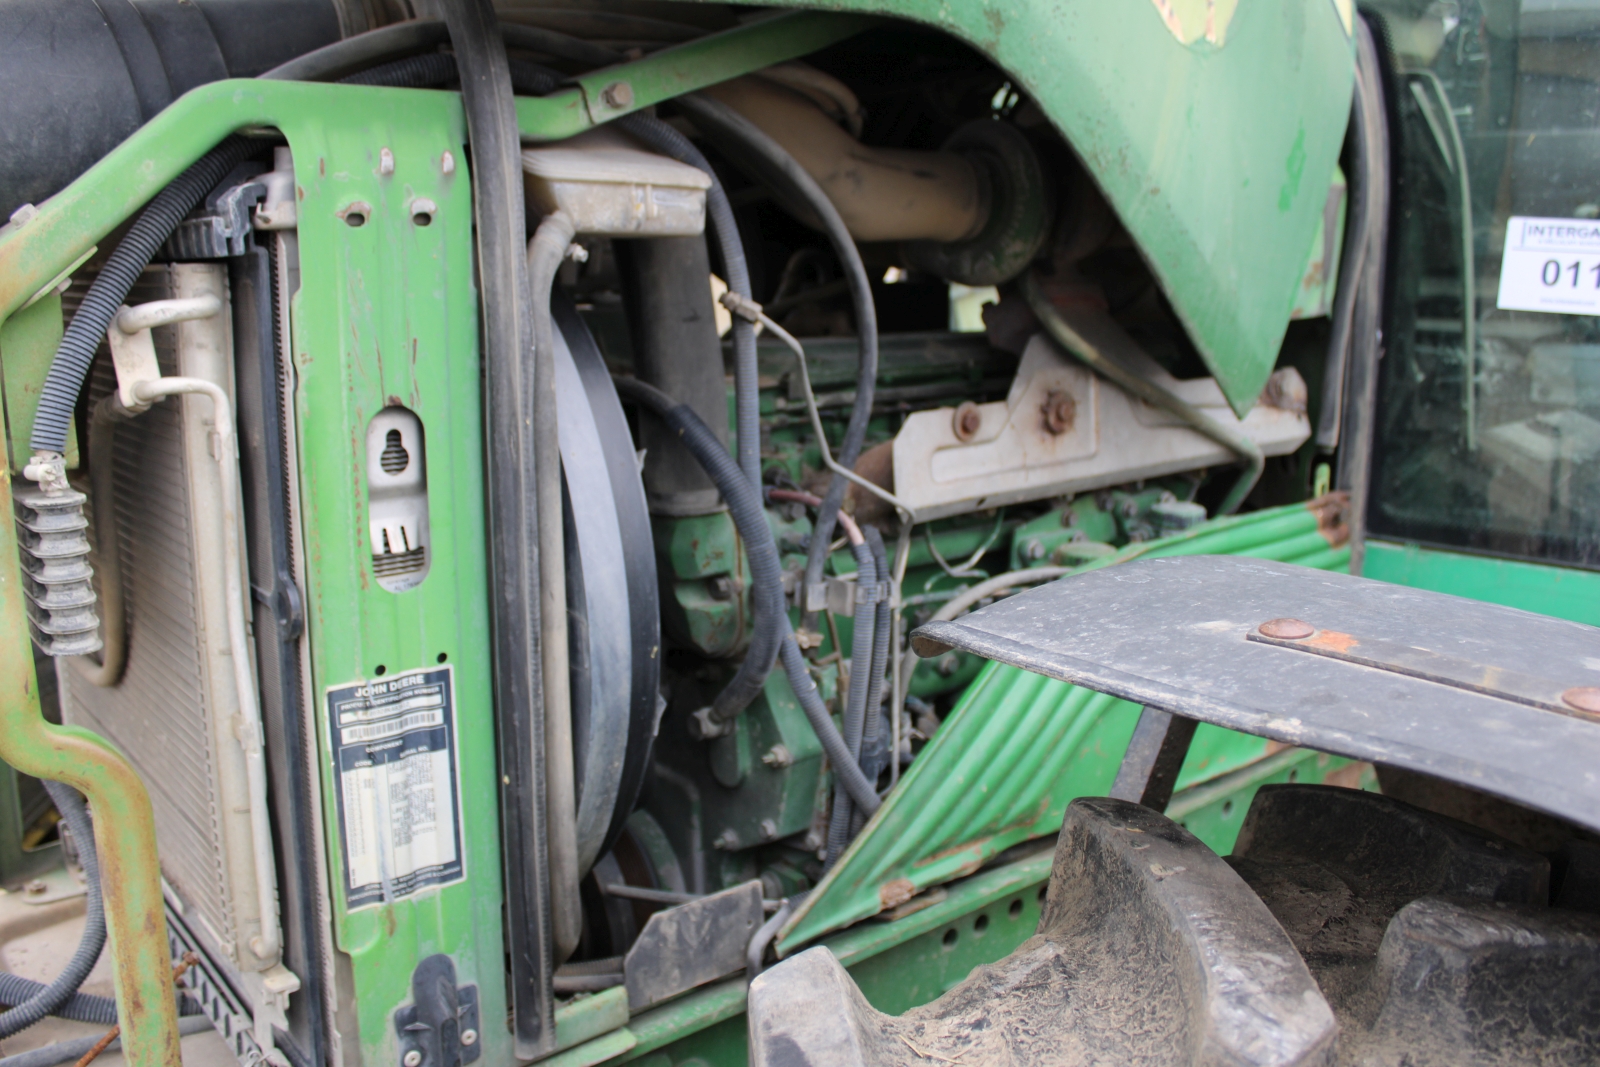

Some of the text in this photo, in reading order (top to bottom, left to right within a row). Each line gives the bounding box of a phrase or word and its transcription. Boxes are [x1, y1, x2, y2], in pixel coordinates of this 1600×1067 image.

[355, 675, 424, 697] JOHN DEERE
[366, 739, 403, 753] COMPONENT
